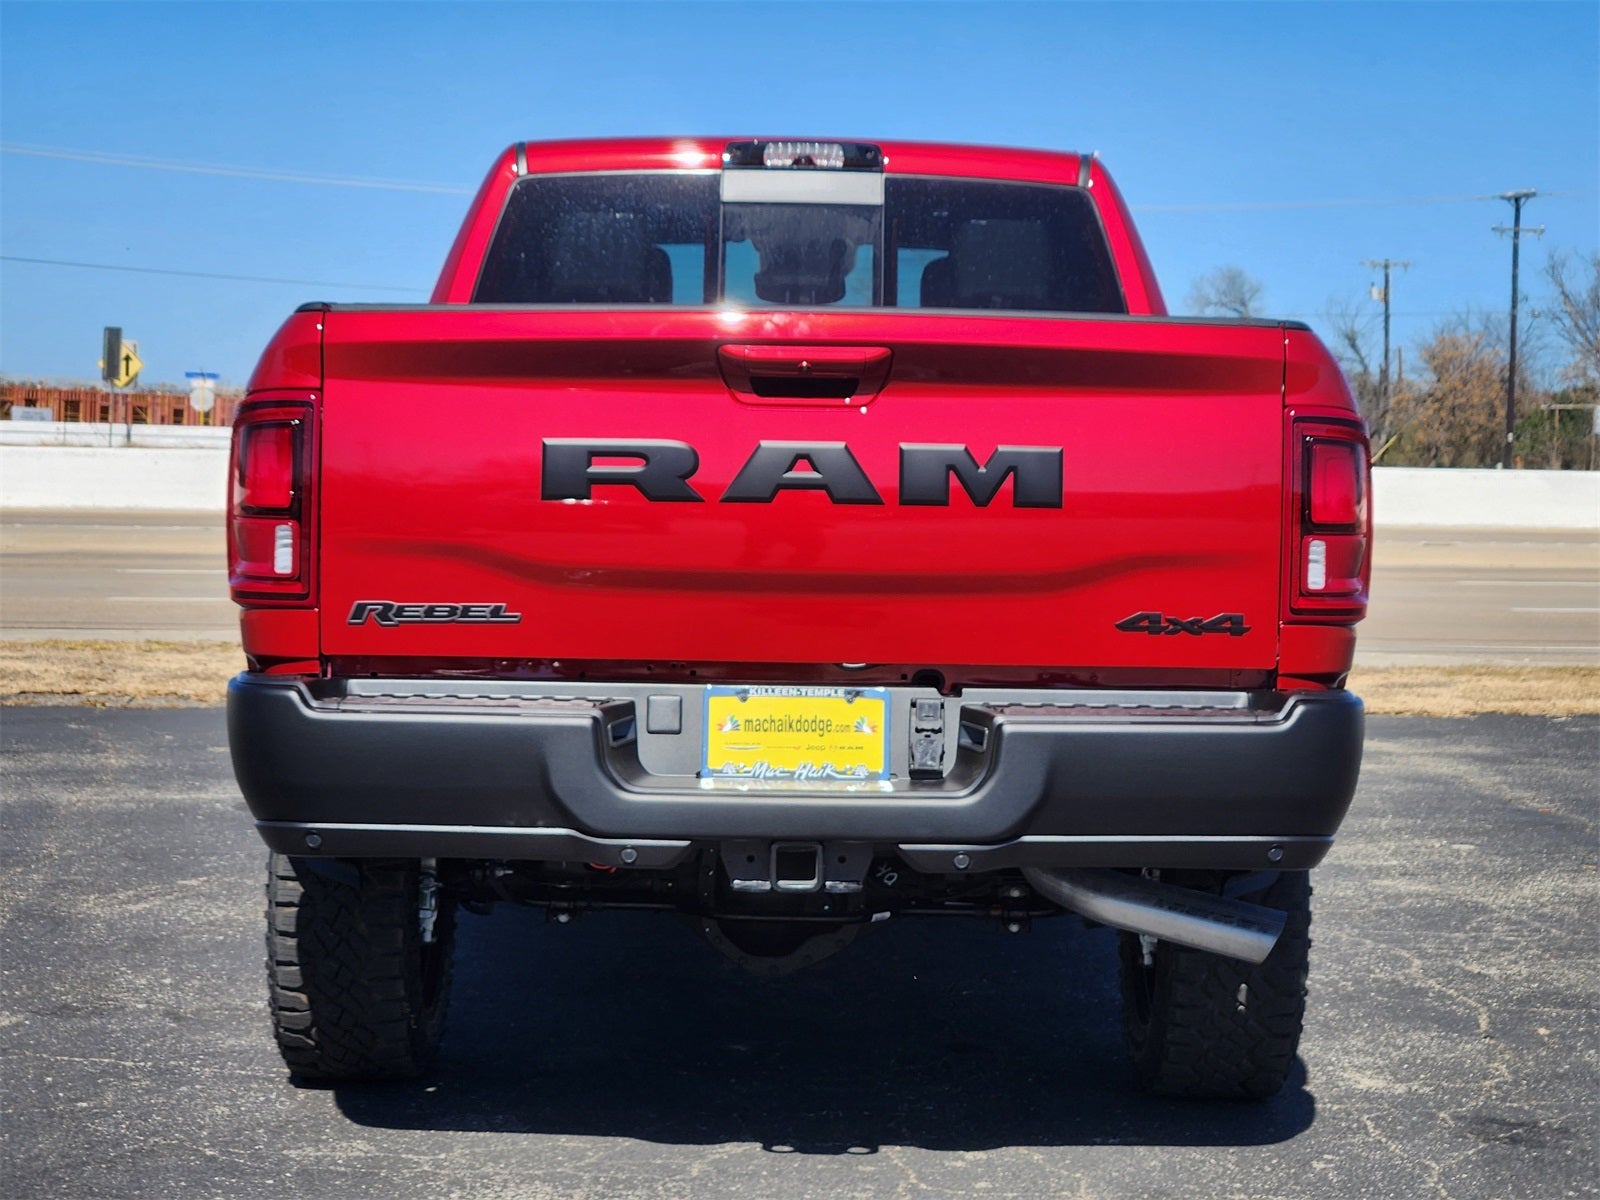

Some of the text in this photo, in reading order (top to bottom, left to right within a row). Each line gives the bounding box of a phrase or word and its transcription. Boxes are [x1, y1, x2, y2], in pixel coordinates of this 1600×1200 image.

[541, 437, 1064, 508] RAM
[348, 600, 522, 627] REBEL
[1114, 611, 1252, 636] 4x4
[748, 687, 846, 698] KILLEEN-TEMPLE
[744, 714, 851, 737] machaikdodge.com
[750, 762, 838, 780] Mac Haik
